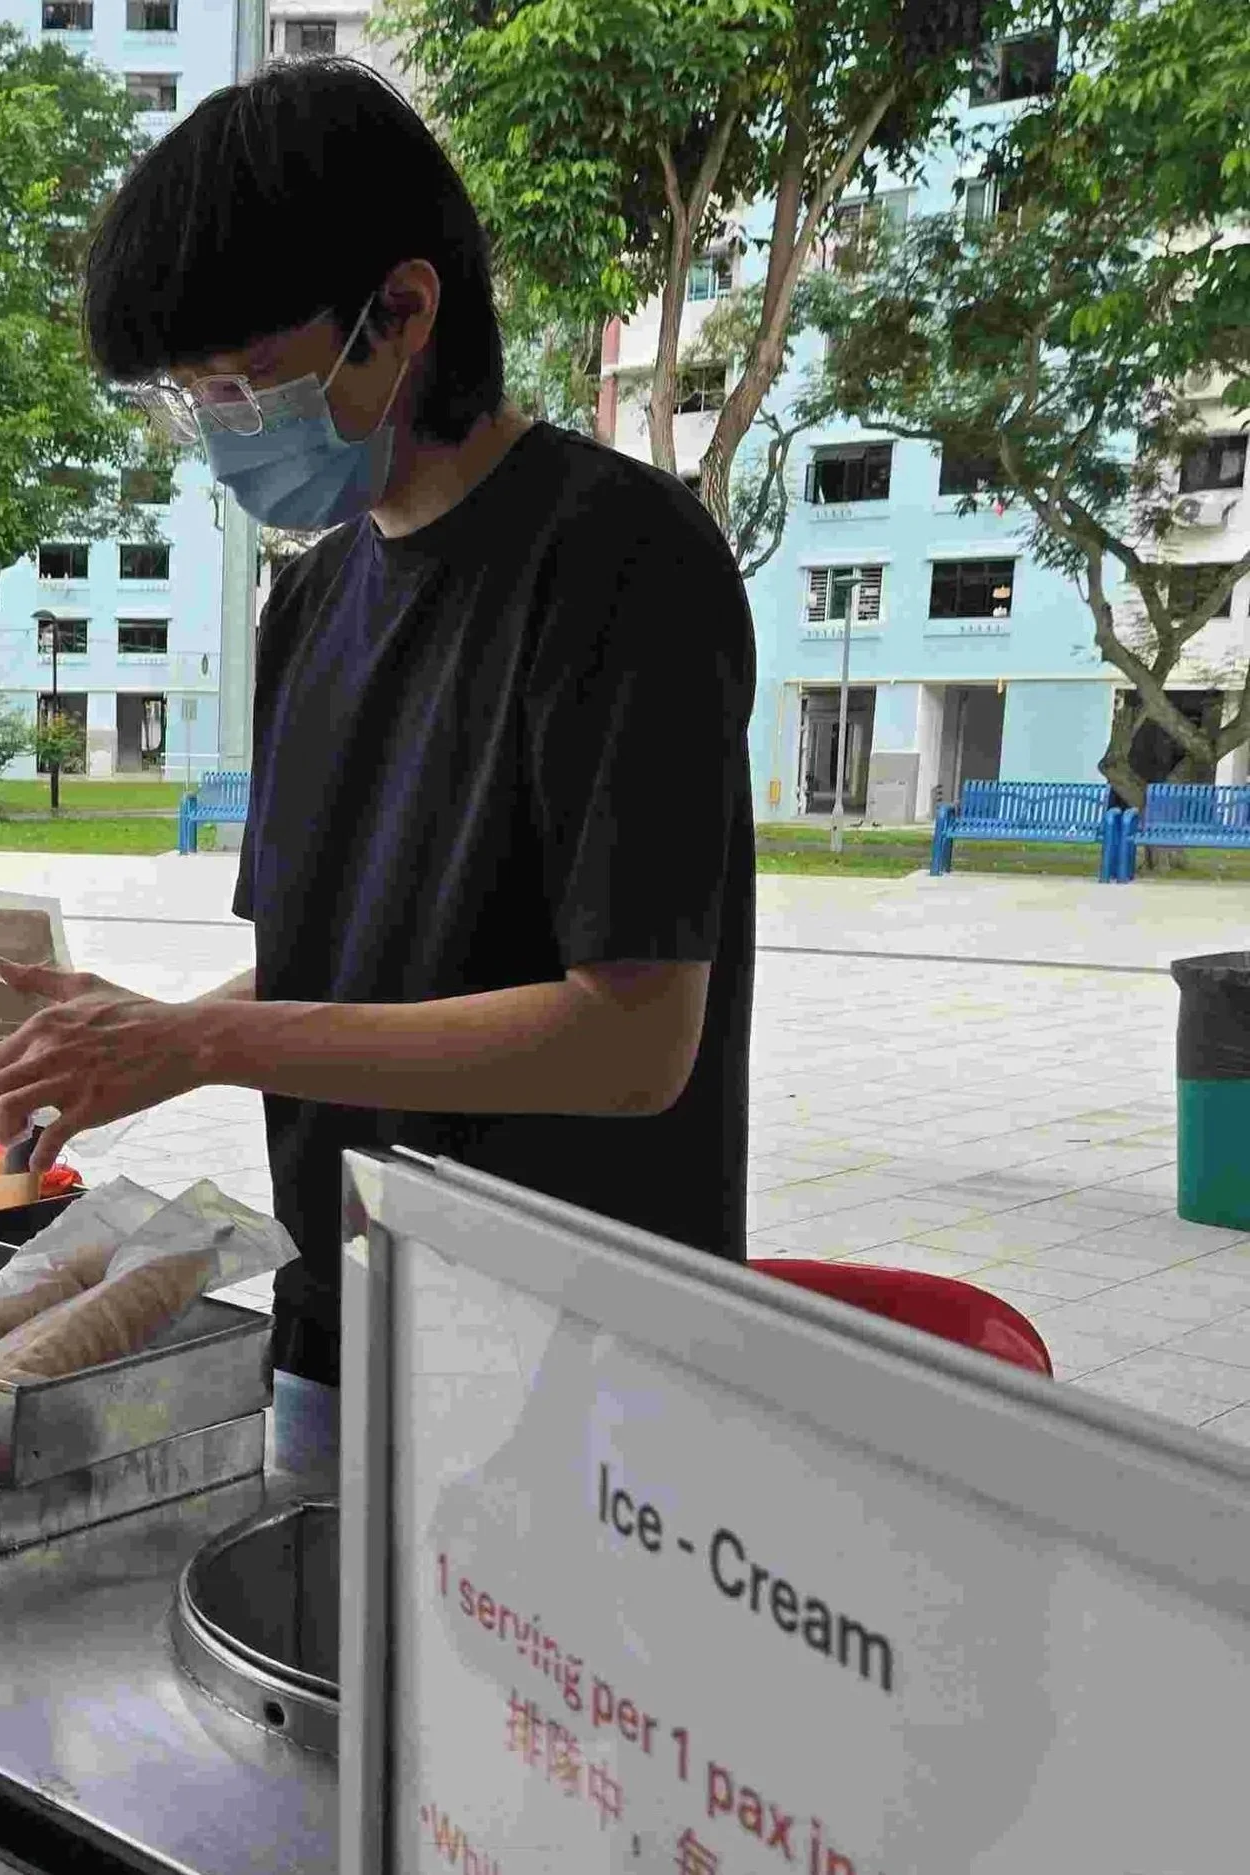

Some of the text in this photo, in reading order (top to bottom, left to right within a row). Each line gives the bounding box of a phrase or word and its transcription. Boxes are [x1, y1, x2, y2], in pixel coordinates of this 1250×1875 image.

[436, 1552, 448, 1597] 1
[458, 1577, 584, 1712] serving
[591, 1675, 658, 1756] per
[670, 1726, 689, 1782] 1
[706, 1760, 795, 1862] pax
[598, 1462, 663, 1552] Ice
[708, 1527, 894, 1693] Cream
